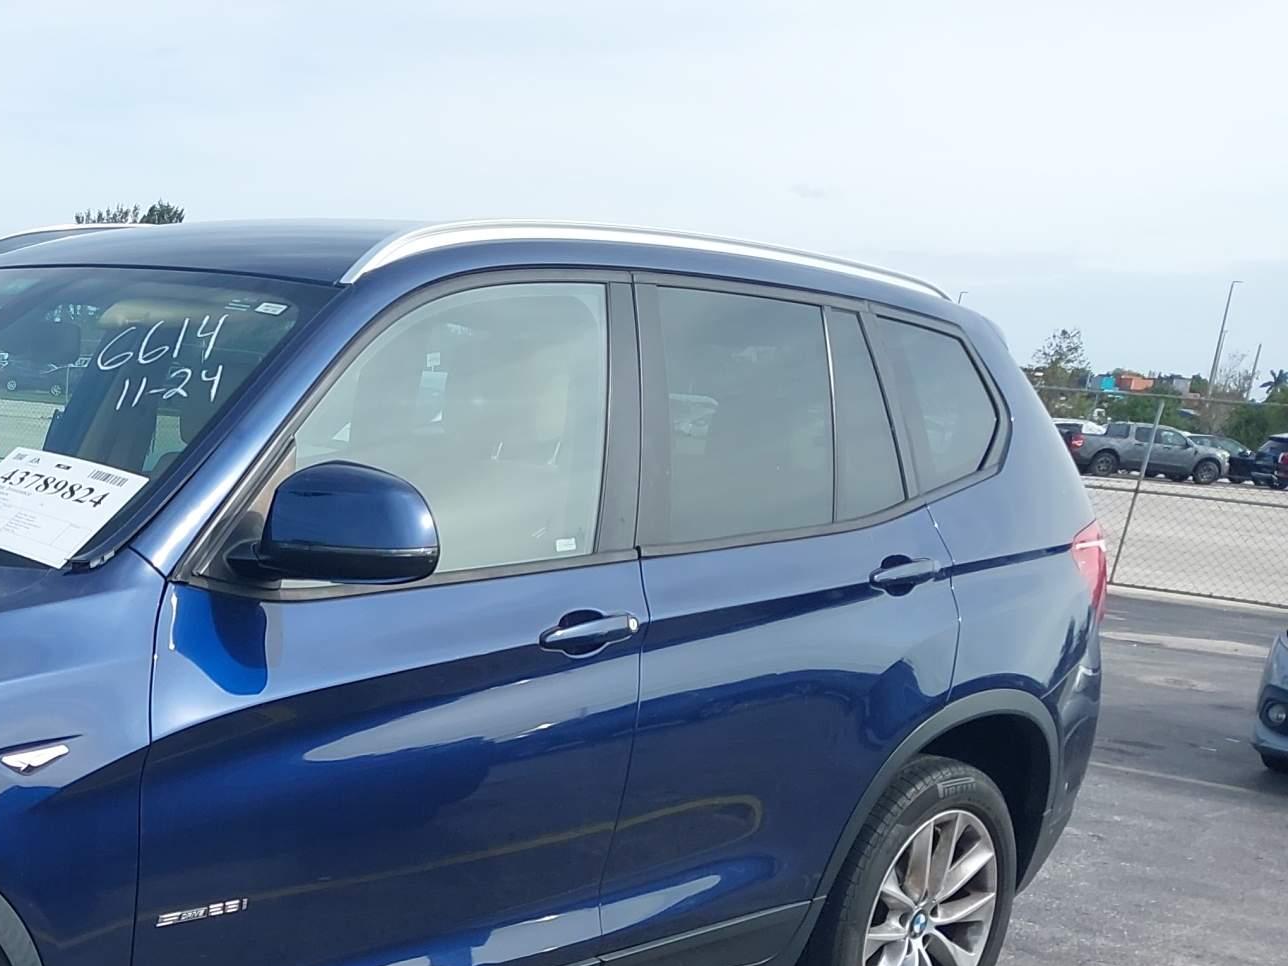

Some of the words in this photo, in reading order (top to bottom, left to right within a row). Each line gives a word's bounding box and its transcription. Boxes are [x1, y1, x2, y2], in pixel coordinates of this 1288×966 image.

[97, 314, 229, 370] 6614
[116, 365, 223, 410] 11-24
[0, 469, 110, 508] 43789824
